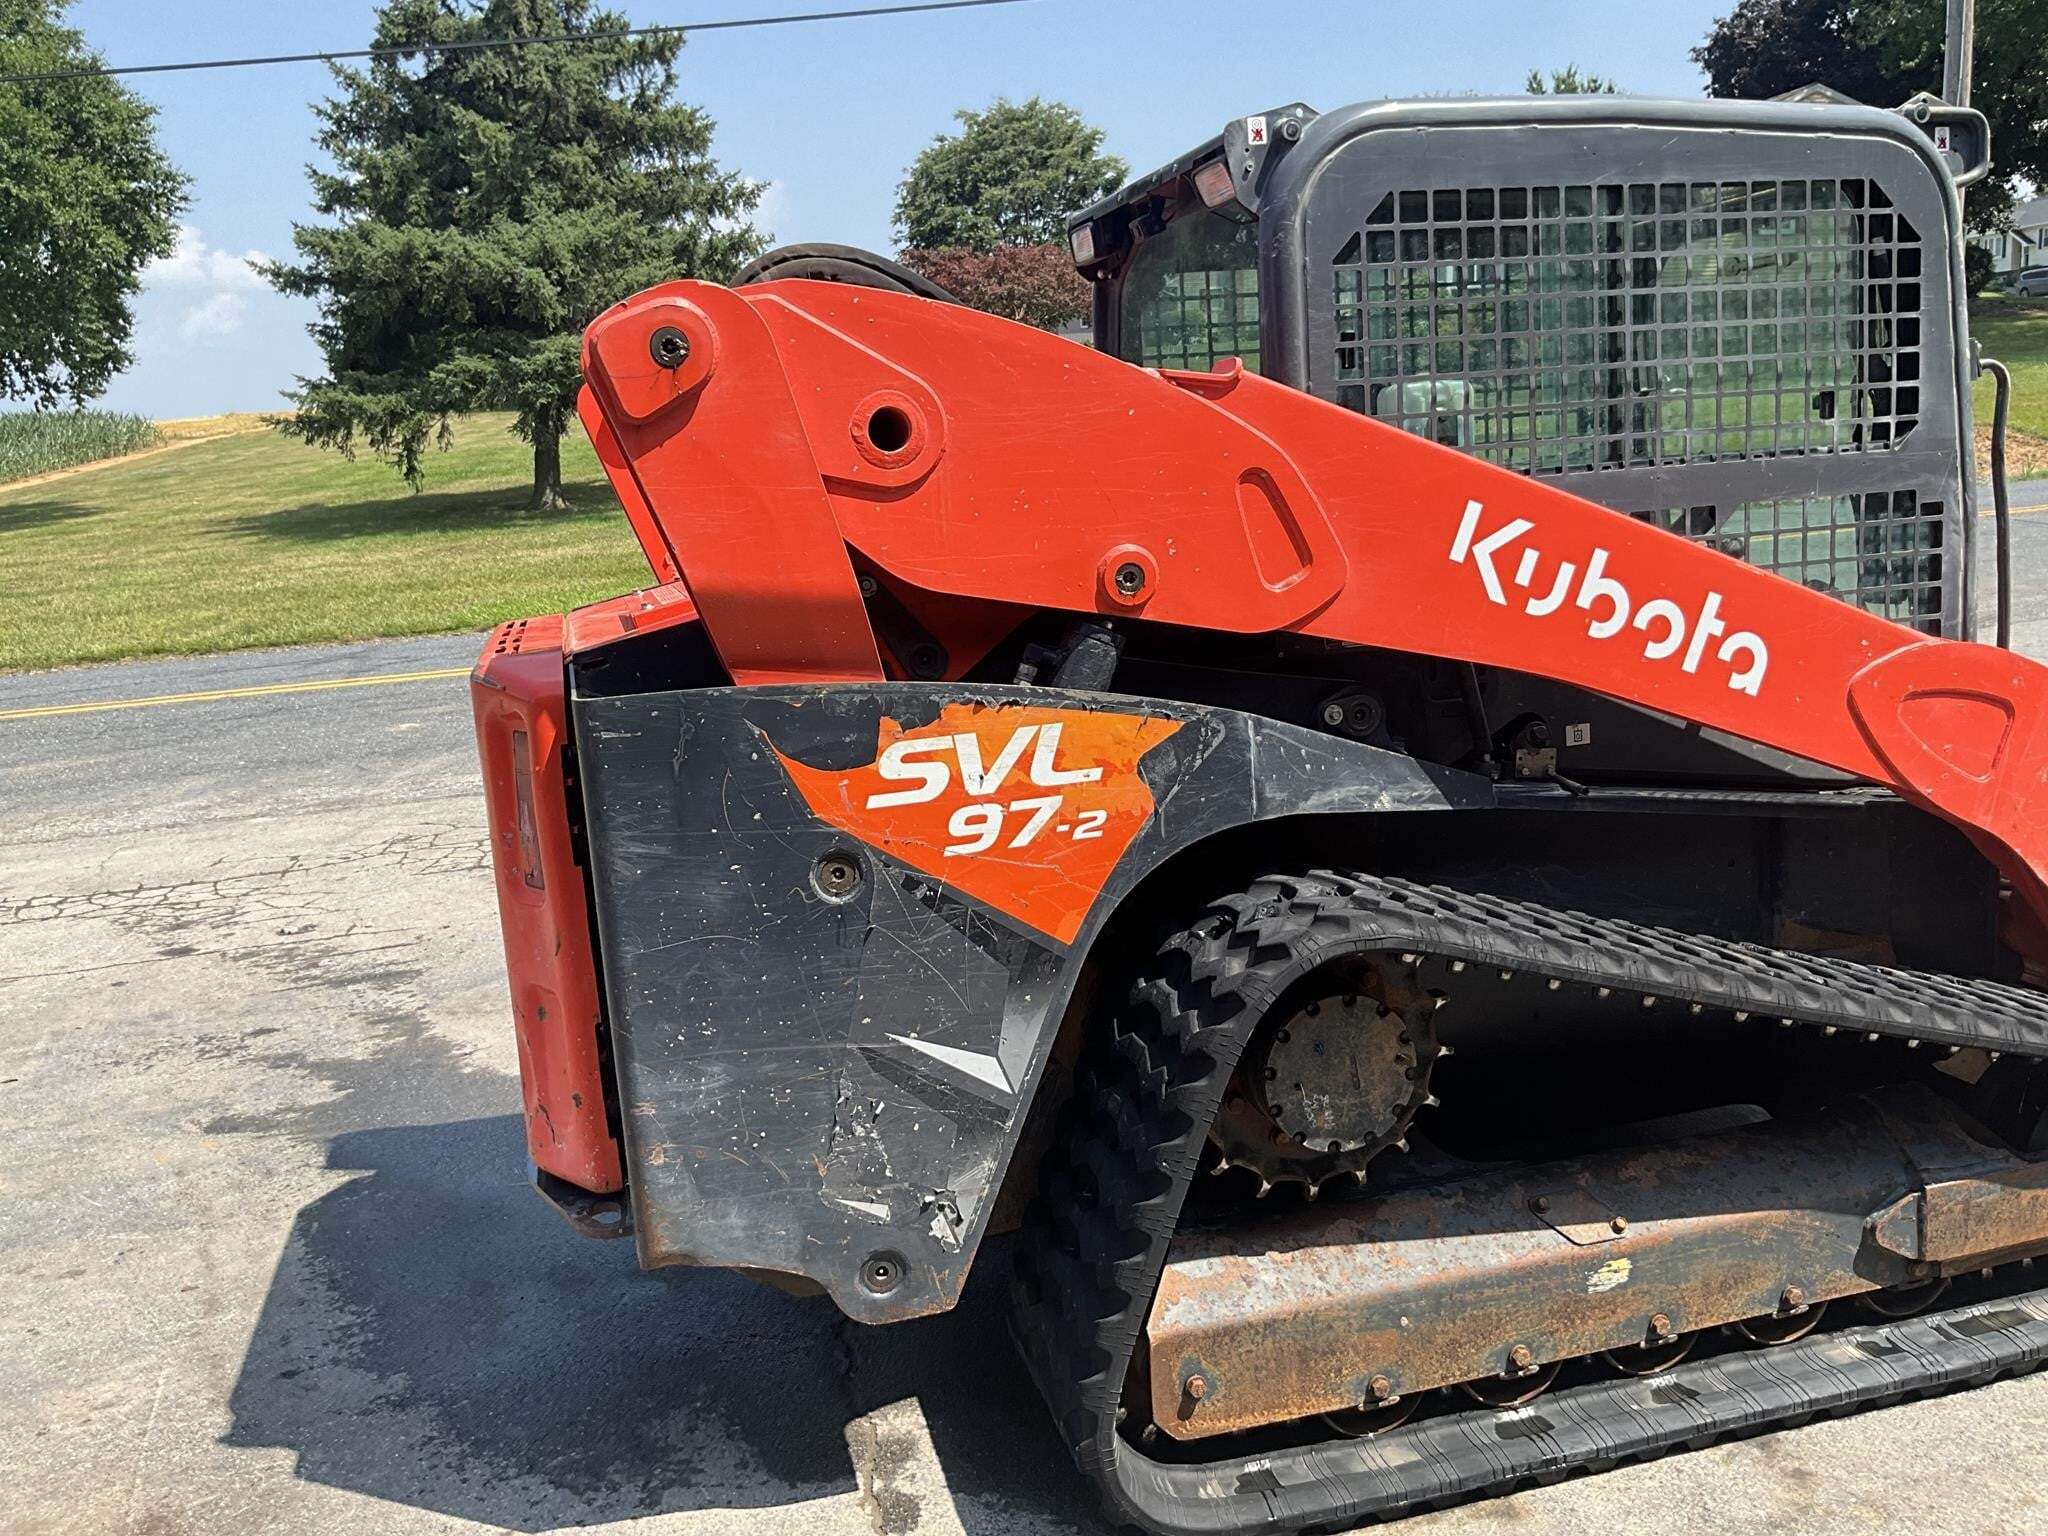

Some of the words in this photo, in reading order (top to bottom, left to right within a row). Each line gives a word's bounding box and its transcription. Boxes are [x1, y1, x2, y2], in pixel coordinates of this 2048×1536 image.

[1449, 499, 1768, 696] Kubota
[866, 722, 1103, 809] SVL
[944, 796, 1107, 857] 97-2
